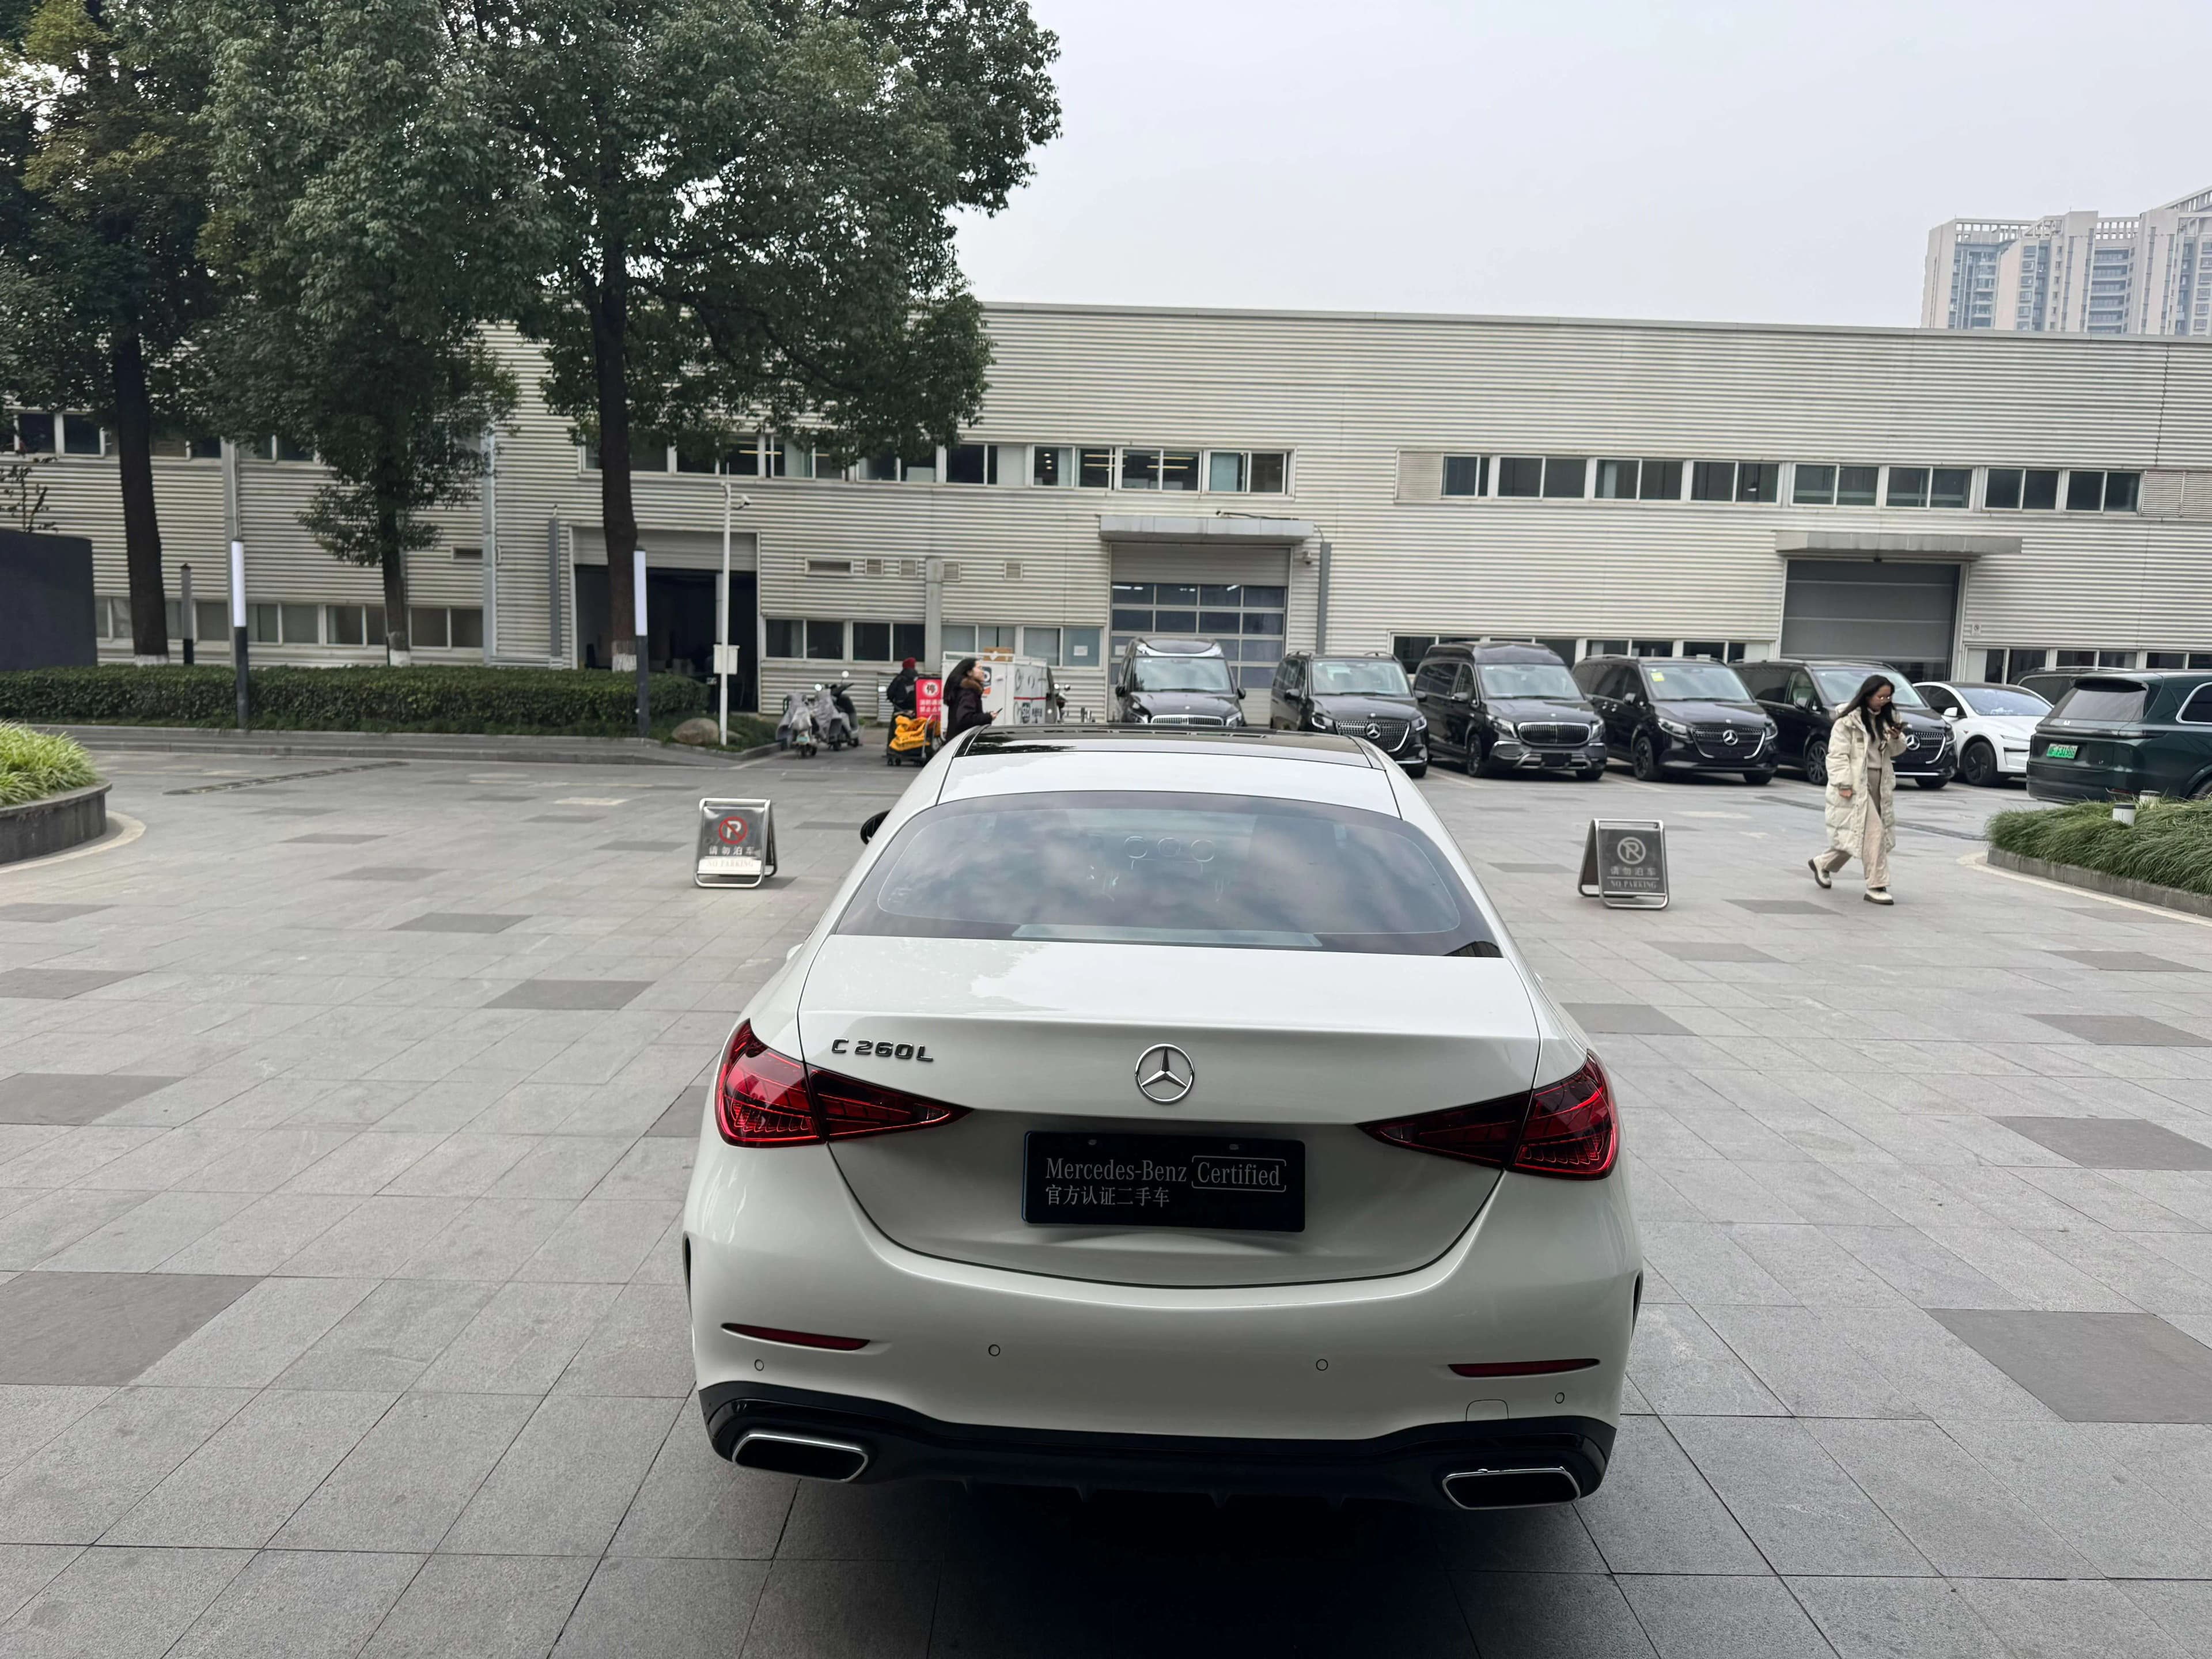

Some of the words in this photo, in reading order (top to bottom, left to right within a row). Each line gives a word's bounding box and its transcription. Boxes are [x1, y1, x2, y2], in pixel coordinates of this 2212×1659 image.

[1611, 866, 1656, 876] 请勿泊车
[1611, 880, 1622, 888] NO
[1624, 880, 1657, 889] PARKING
[831, 1037, 850, 1054] C
[854, 1039, 934, 1063] 260L
[1045, 1157, 1187, 1182] Mercedes-Benz
[1197, 1161, 1281, 1186] Certified
[1045, 1184, 1171, 1208] 官方认证二手车
